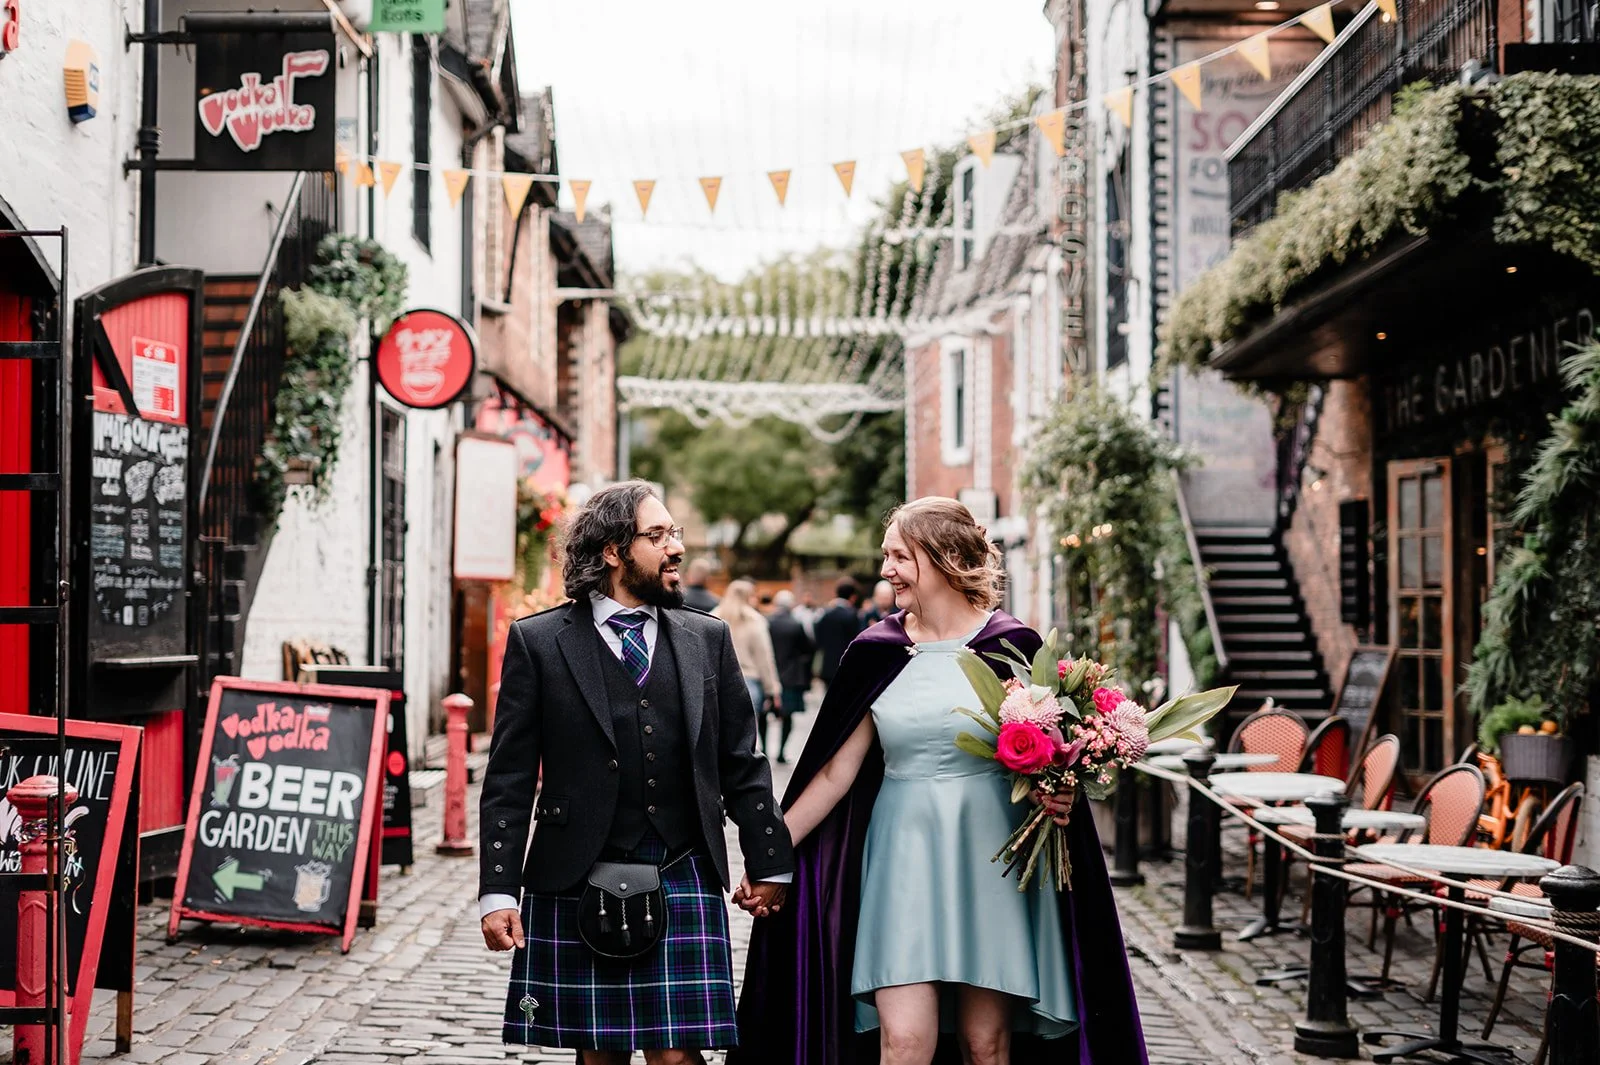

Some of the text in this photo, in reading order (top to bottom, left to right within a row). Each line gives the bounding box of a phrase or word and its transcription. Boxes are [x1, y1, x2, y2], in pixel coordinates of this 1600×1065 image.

[1435, 308, 1594, 416] GARDENER
[238, 762, 363, 820] BEER
[200, 810, 354, 856] GARDEN THIS
[312, 839, 349, 863] WAY
